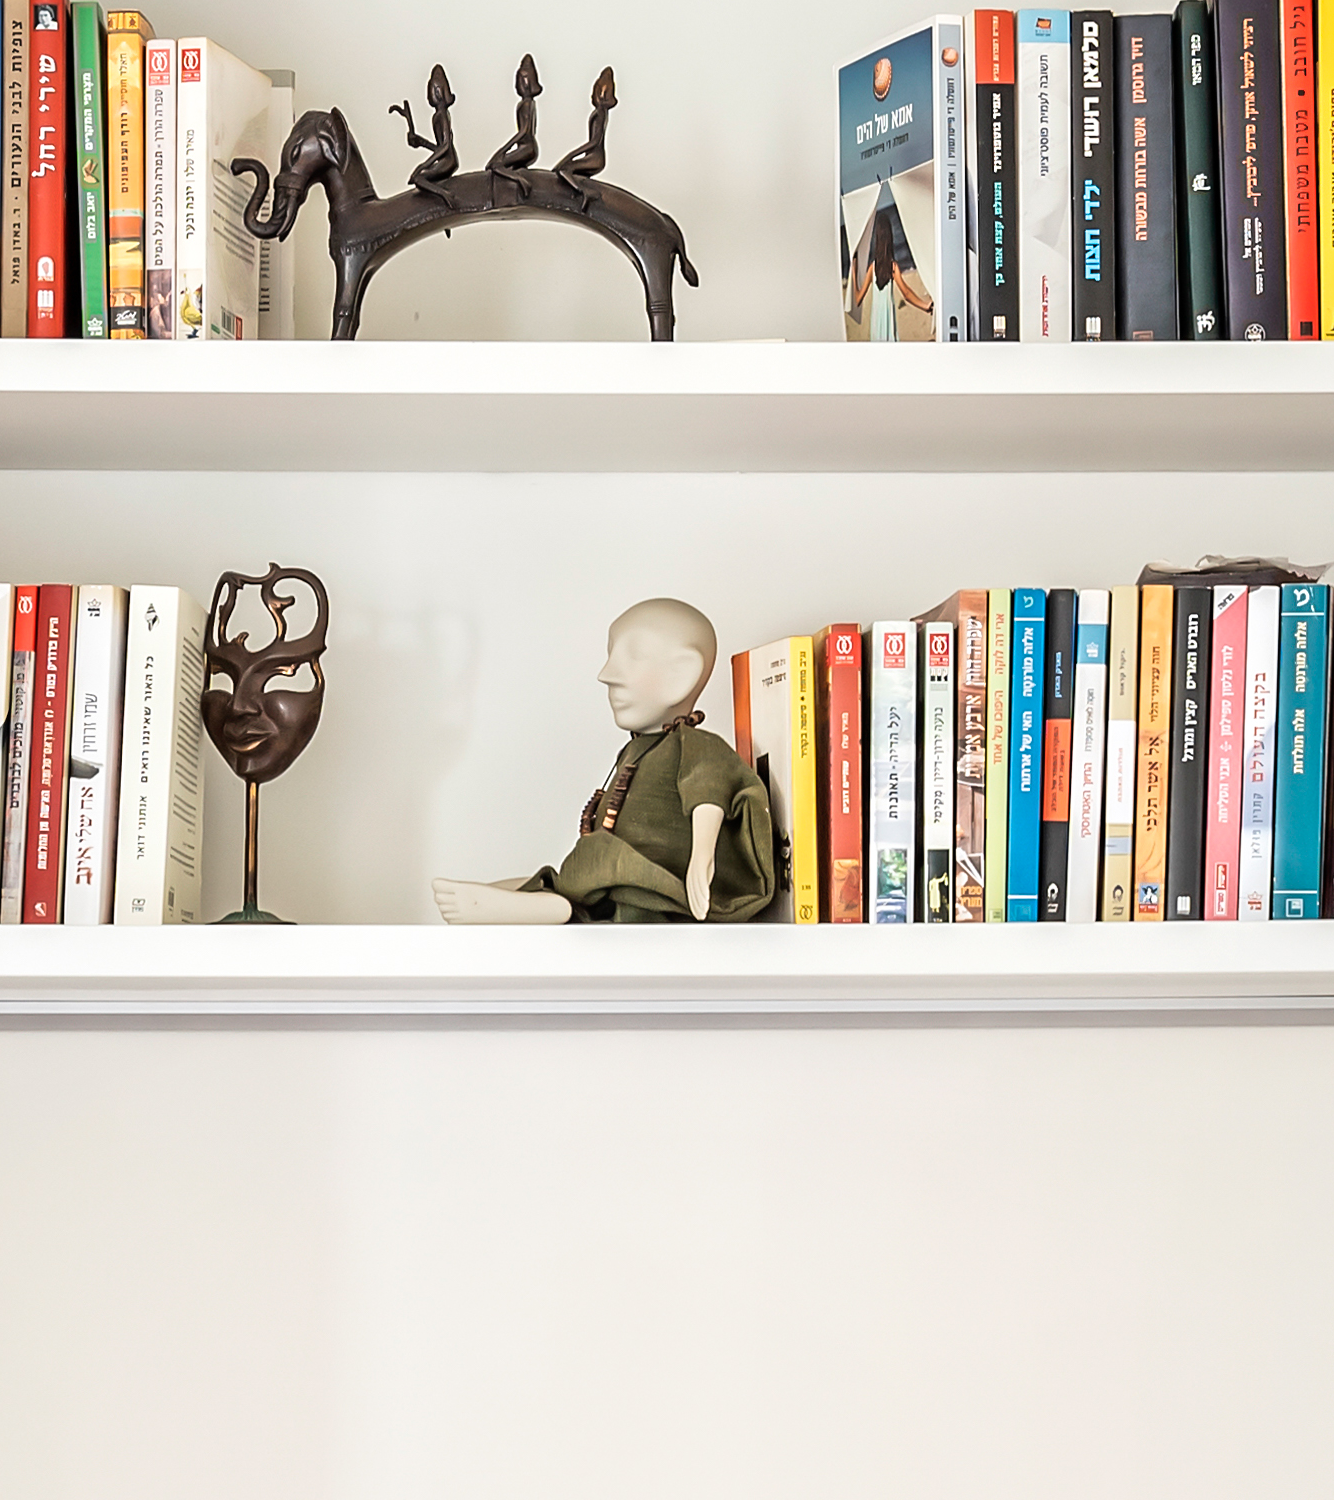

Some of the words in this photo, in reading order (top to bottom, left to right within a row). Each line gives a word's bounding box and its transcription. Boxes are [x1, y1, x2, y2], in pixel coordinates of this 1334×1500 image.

[1290, 6, 1305, 29] גיל
[1082, 22, 1101, 88] סלמאן
[1131, 37, 1143, 60] דויד
[1294, 37, 1306, 76] חובב
[39, 55, 57, 112] שירי
[1132, 63, 1147, 103] גרוסמן
[155, 90, 163, 116] שפרה
[891, 103, 913, 130] אמא
[155, 120, 164, 141] הורן
[856, 120, 873, 145] הים
[874, 113, 888, 136] של
[1084, 97, 1099, 157] רושדי
[1135, 118, 1146, 146] אשה
[1296, 110, 1308, 156] מטבח
[32, 127, 55, 177] רחל
[186, 130, 194, 155] מאיר
[184, 159, 194, 176] שלו
[1135, 150, 1146, 188] בורחת
[153, 184, 163, 217] הולכת
[186, 186, 194, 209] יונה
[1083, 180, 1100, 220] ילדי
[1297, 165, 1310, 232] משפחתי
[153, 222, 164, 235] על
[186, 213, 195, 239] ונער
[1135, 192, 1147, 240] מבשורה
[155, 239, 163, 265] המים
[1085, 229, 1100, 281] חצות
[996, 614, 1004, 626] ארי
[1188, 614, 1198, 649] רוברט
[996, 634, 1004, 646] דה
[145, 656, 153, 669] כל
[993, 650, 1006, 674] לוקה
[1222, 646, 1233, 666] לורי
[1186, 652, 1197, 689] האריס
[1221, 670, 1234, 696] נלסון
[994, 691, 1003, 721] היפוכו
[1185, 699, 1197, 725] קצין
[1219, 700, 1233, 736] ספילמן
[143, 707, 151, 745] שאיננו
[992, 725, 1003, 740] של
[994, 744, 1002, 764] אחד
[1182, 728, 1194, 762] ומרגל
[141, 751, 149, 782] רואים
[1220, 758, 1229, 780] אבני
[139, 796, 147, 829] אנתוני
[1217, 784, 1228, 823] הסליחה
[137, 836, 145, 859] דואר
